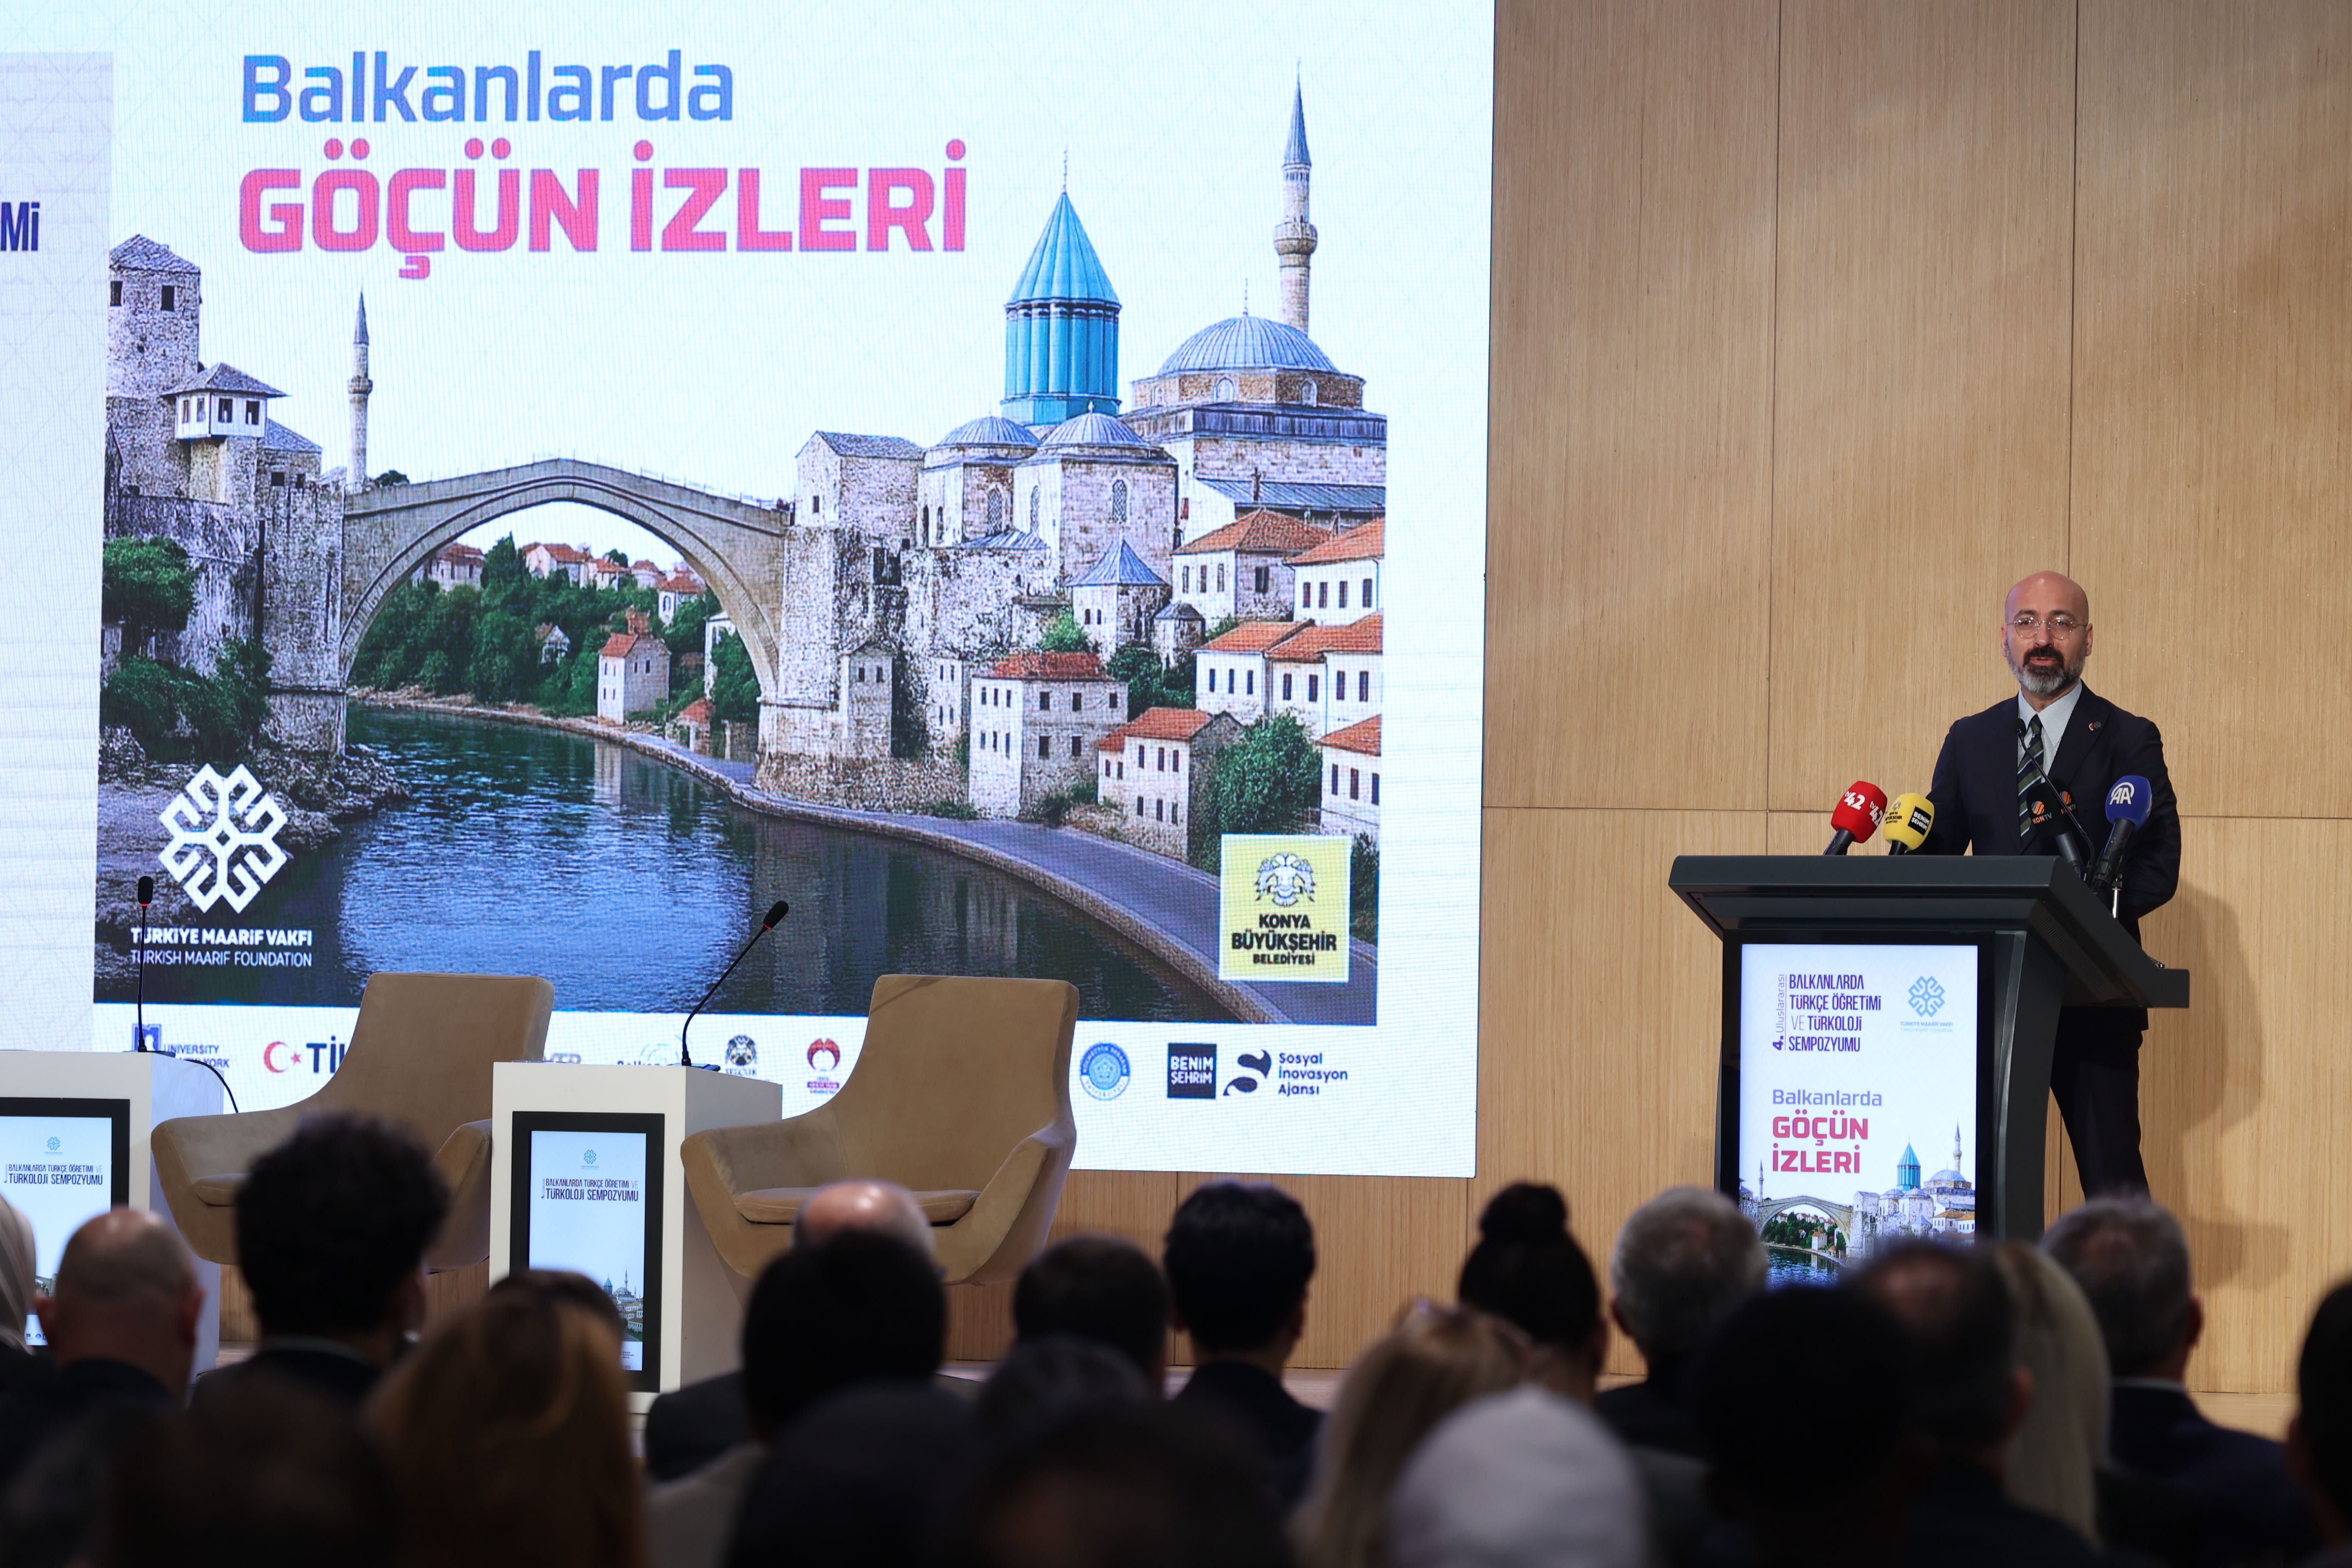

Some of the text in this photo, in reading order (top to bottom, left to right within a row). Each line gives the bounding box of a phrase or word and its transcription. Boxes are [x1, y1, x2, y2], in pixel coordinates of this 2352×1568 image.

[243, 49, 733, 122] Balkanlarda
[239, 138, 966, 279] GÖÇÜN İZLERİ
[2109, 782, 2135, 804] AA
[1259, 914, 1311, 928] KONYA
[266, 928, 312, 946] VAKFI
[1232, 929, 1337, 953] BÜYÜKŞEHİR
[130, 949, 312, 967] TURKISH MAARIF FOUNDATION
[1253, 952, 1315, 965] BELEDİYESİ
[1789, 974, 1864, 990] BALKANLARDA
[1789, 993, 1881, 1013] TÜRKÇE ÖĞRETİMİ
[1791, 1015, 1862, 1031] VE TÜRKOLOJİ
[164, 1043, 220, 1054] UNIVERSITY
[1789, 1036, 1860, 1052] SEMPOZYUMU
[1279, 1053, 1323, 1066] Sosyal
[1278, 1082, 1319, 1097] Ajansı
[1773, 1089, 1882, 1106] Balkanlarda
[1773, 1109, 1868, 1146] GÖÇÜN
[1773, 1143, 1860, 1173] İZLERİ
[9, 1164, 46, 1172] BALKANLARDA
[51, 1174, 103, 1185] SEMPOZYUMU
[546, 1178, 582, 1187] BALKANLARDA
[631, 1180, 639, 1189] VE
[587, 1189, 639, 1201] SEMPOZYUMU
